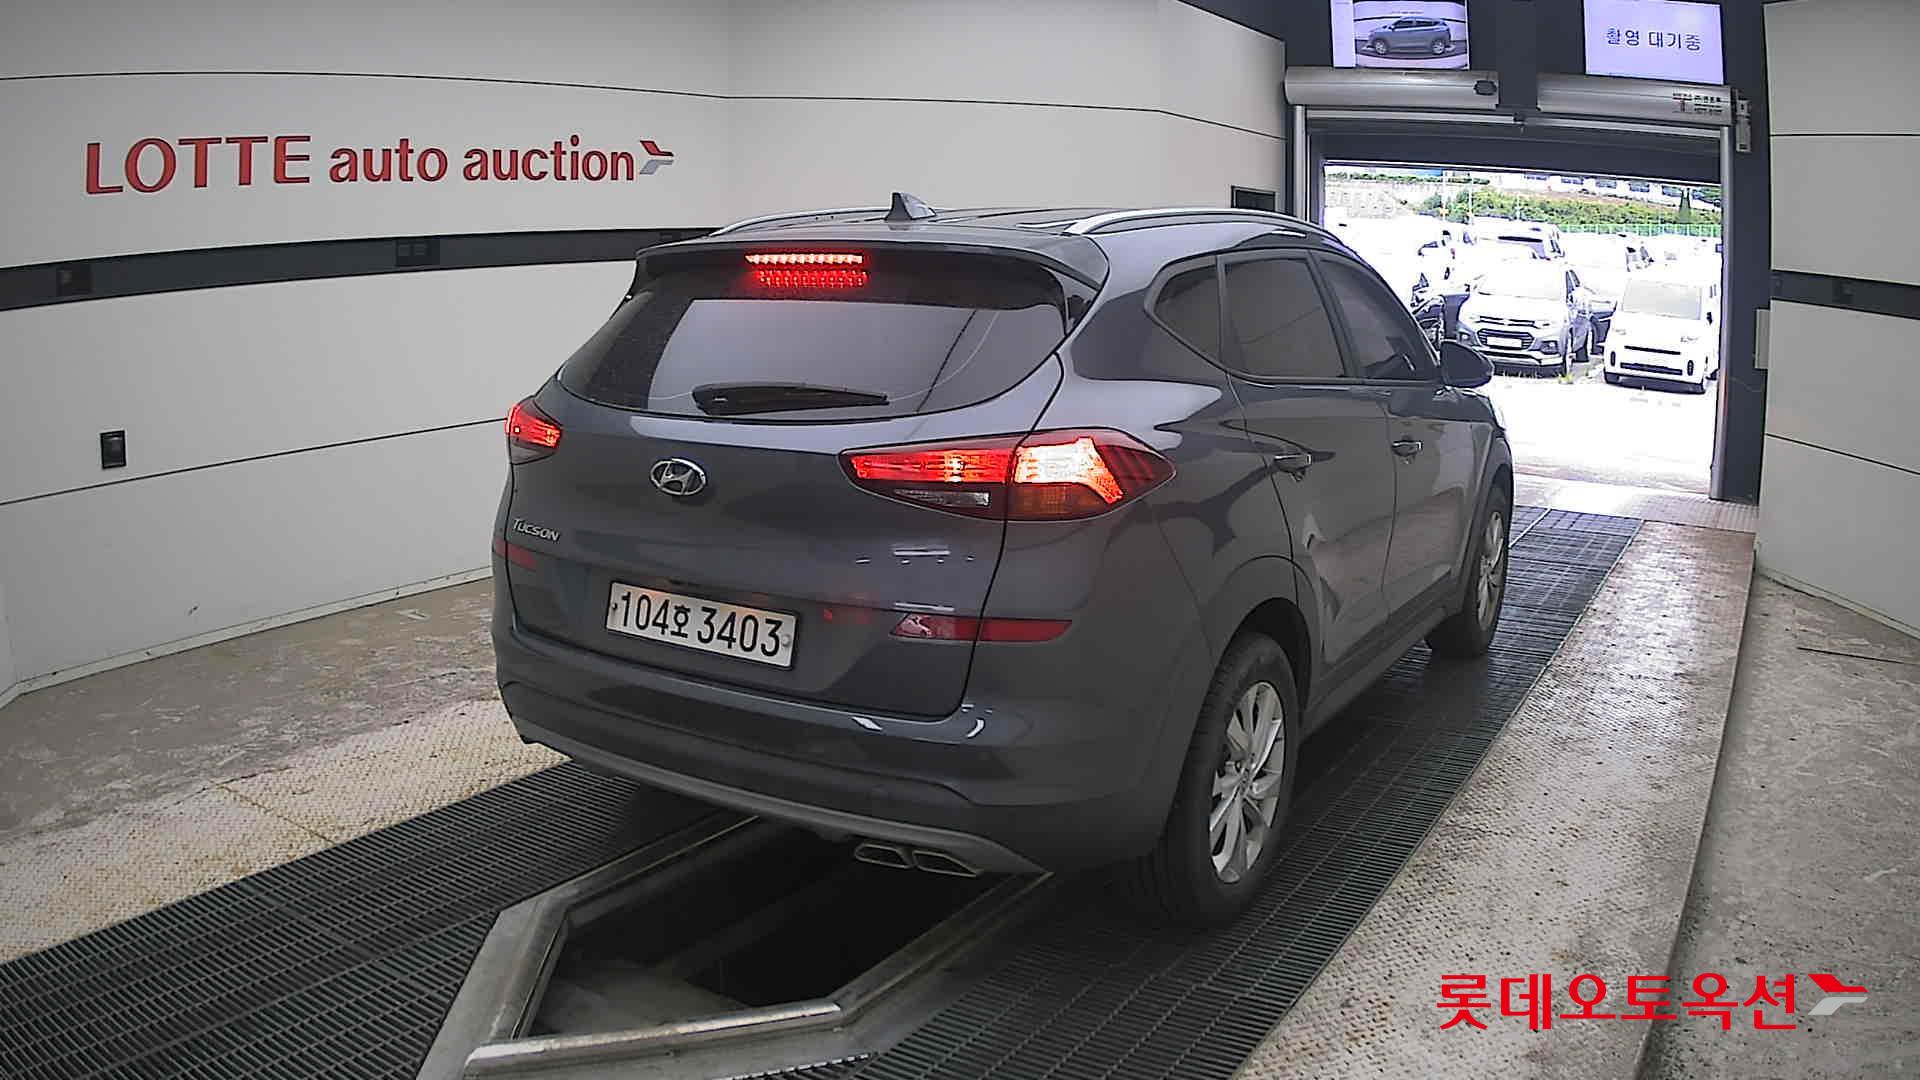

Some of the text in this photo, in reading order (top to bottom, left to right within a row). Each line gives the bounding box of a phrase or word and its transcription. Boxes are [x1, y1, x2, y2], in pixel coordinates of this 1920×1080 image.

[1607, 28, 1701, 51] 촬영 대기중
[85, 134, 634, 194] LOTTE auto auction
[513, 518, 560, 541] TUCSON
[622, 591, 783, 656] 104호 3403
